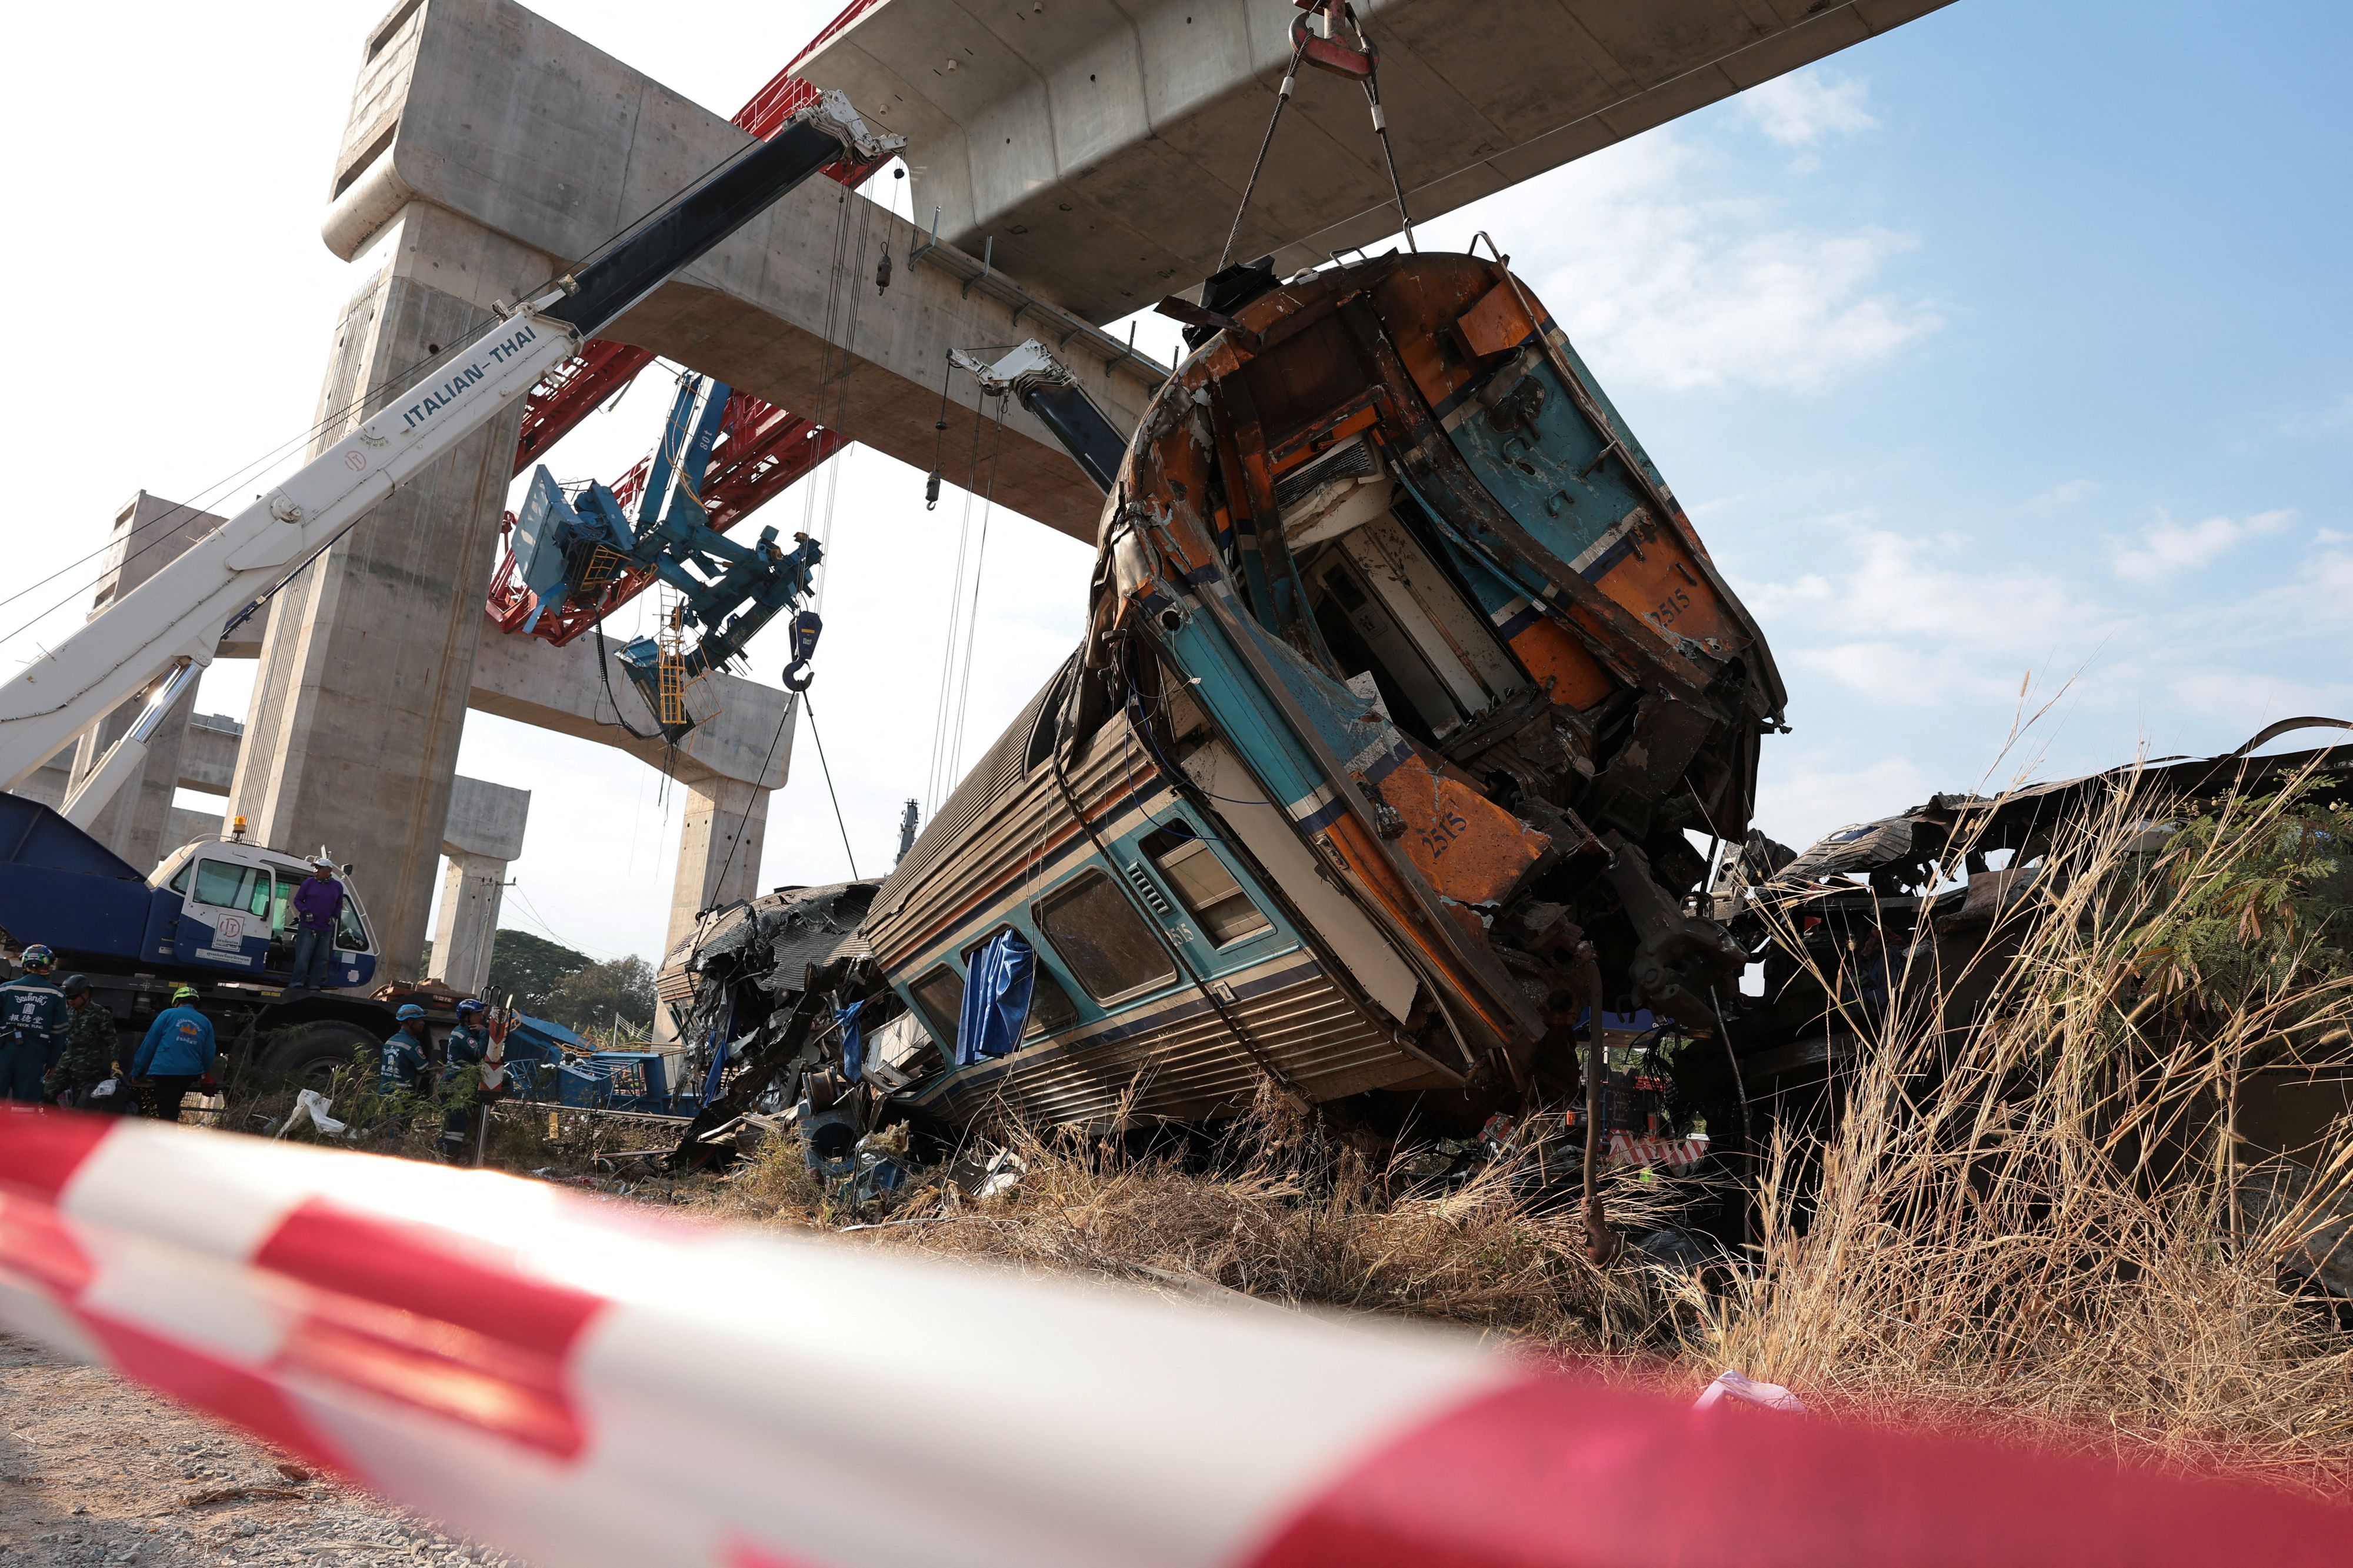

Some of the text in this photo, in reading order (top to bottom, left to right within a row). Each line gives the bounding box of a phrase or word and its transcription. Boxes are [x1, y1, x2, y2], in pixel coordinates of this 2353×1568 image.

[403, 325, 536, 428] ITALIAN-THAI
[699, 430, 712, 450] 80t
[1651, 588, 1690, 628] 2515
[1422, 812, 1467, 858] 2515
[1221, 987, 1231, 999] 2
